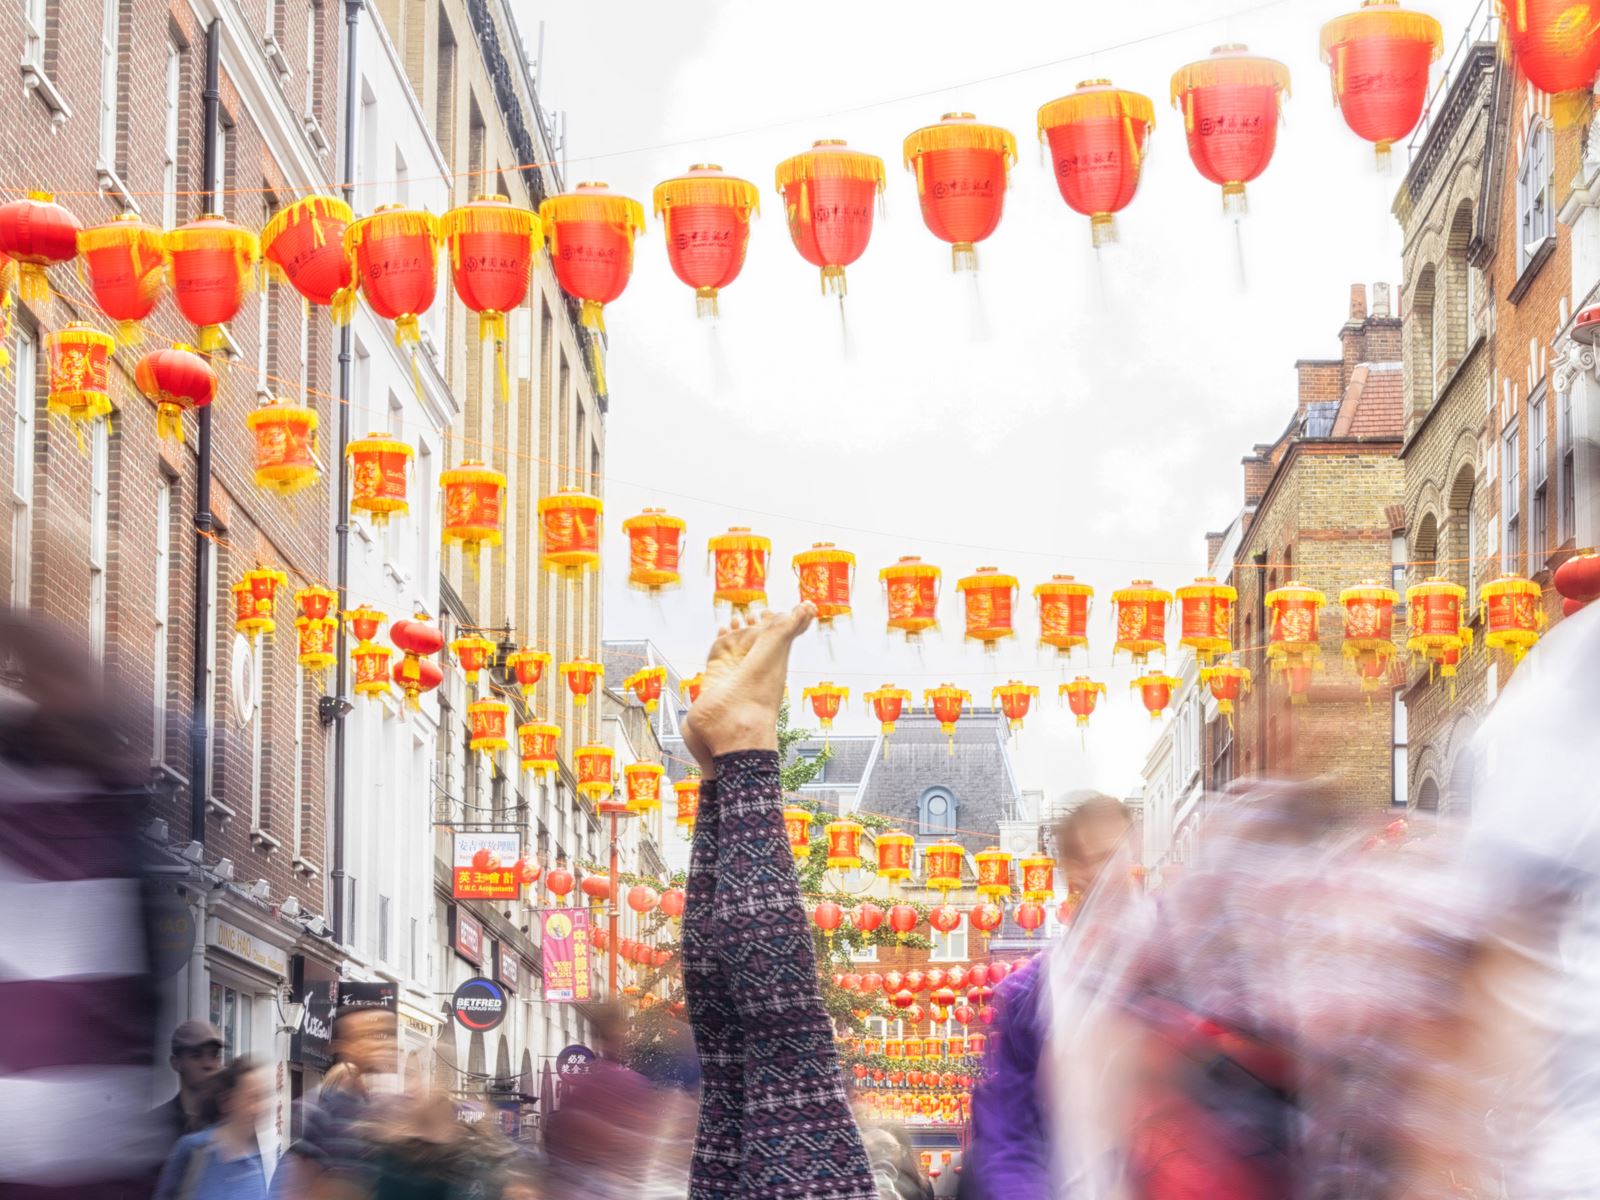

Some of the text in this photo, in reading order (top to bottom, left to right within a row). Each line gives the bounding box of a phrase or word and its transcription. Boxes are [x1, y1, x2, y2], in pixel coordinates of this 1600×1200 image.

[217, 924, 236, 950] DING
[237, 933, 251, 957] HAO
[456, 998, 502, 1007] BETFRED
